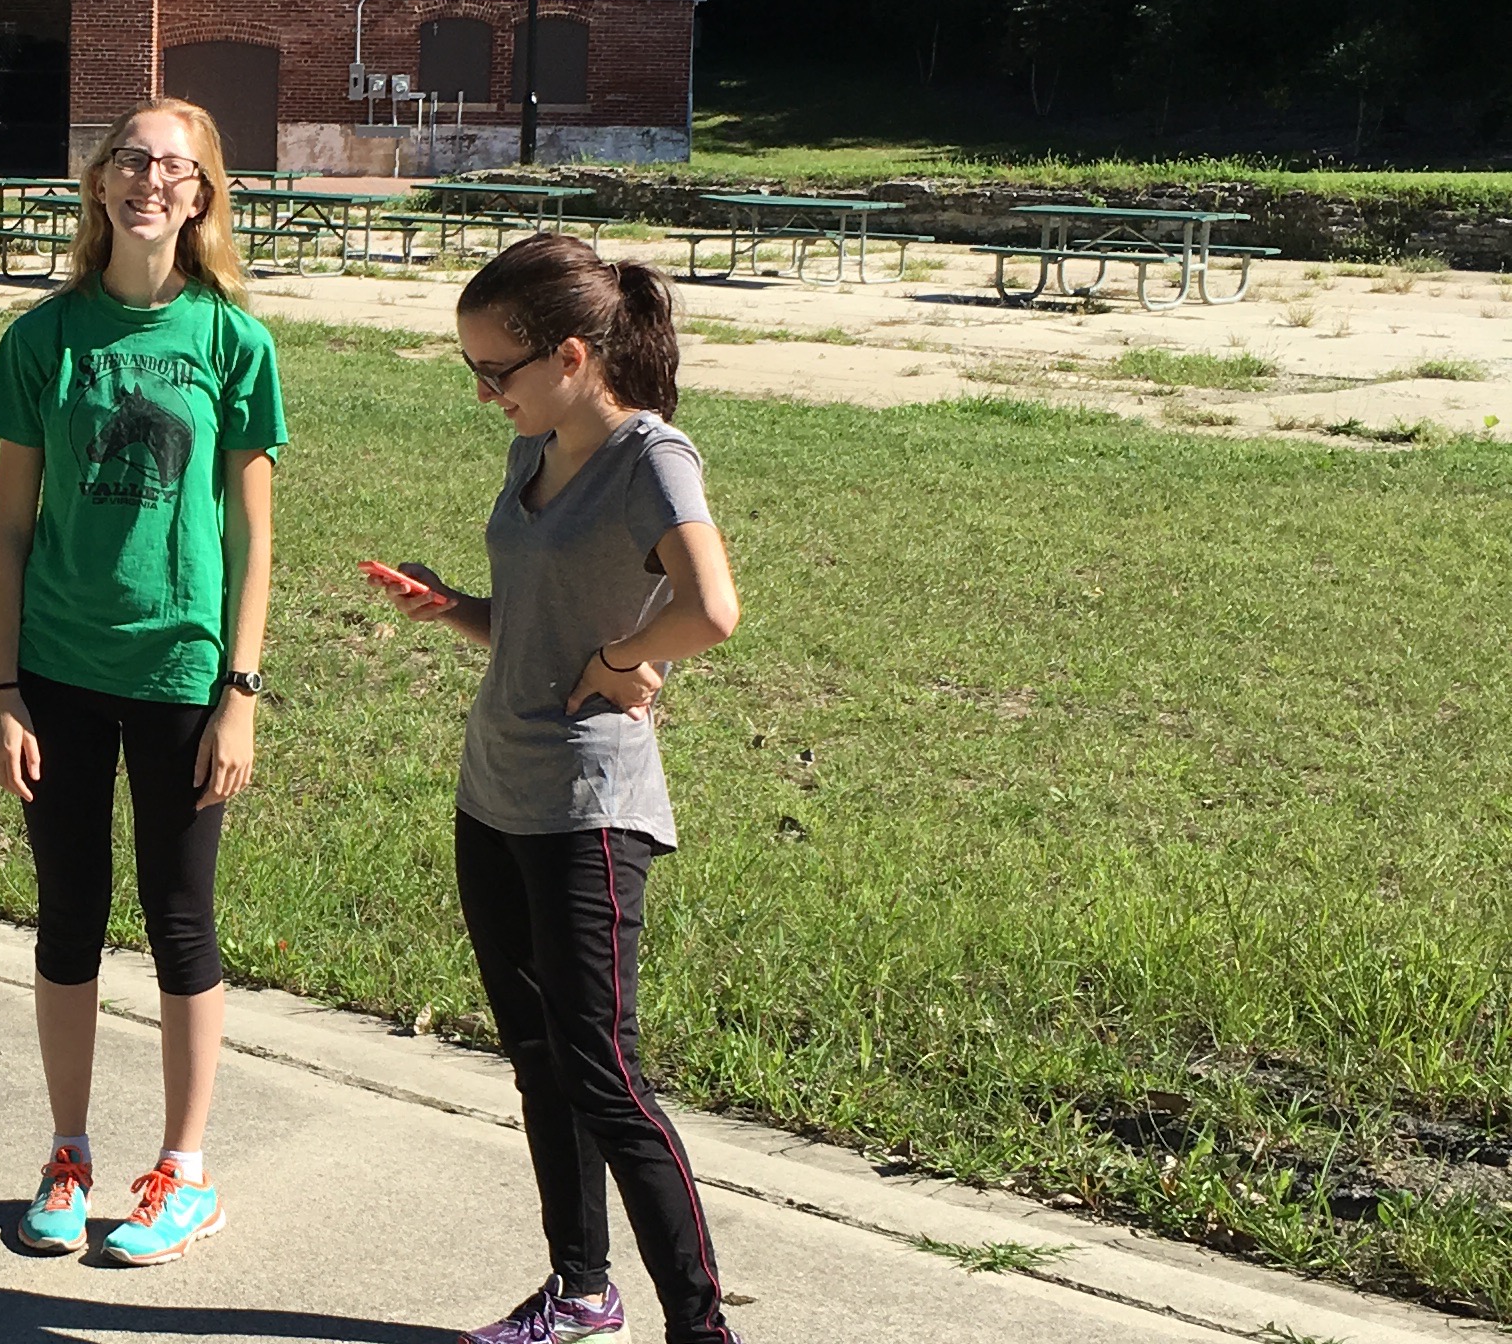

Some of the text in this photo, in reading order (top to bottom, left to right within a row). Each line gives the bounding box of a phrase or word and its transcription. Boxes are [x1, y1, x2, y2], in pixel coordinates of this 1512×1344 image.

[79, 481, 178, 504] VALLEY
[92, 497, 159, 510] OF VIRGINIA
